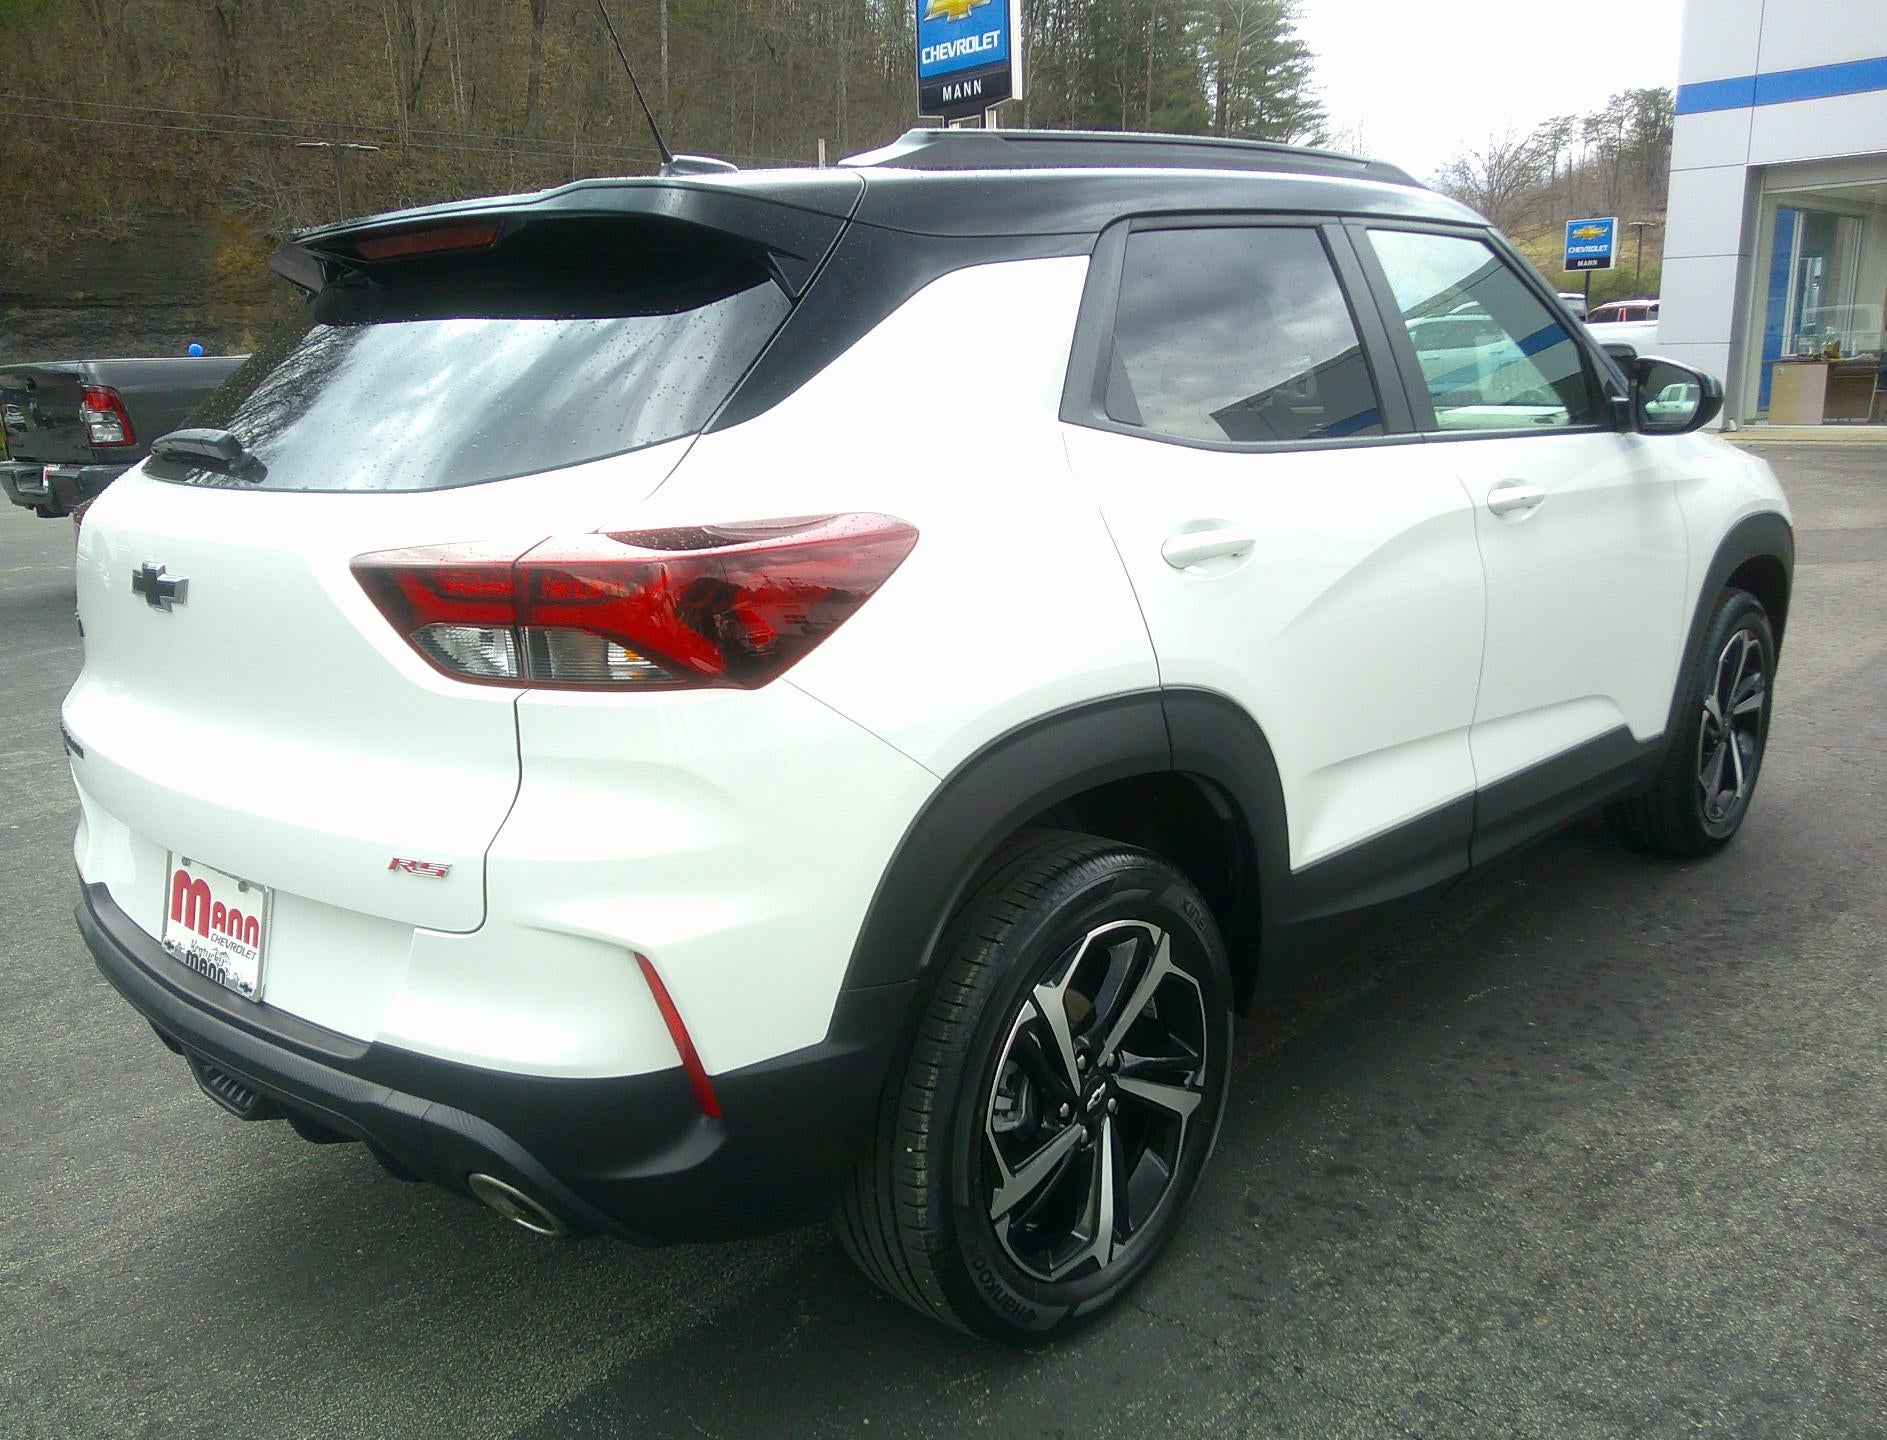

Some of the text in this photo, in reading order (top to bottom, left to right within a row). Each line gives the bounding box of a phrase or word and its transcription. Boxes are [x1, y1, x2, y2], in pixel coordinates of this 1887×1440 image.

[921, 30, 1001, 65] CHEVROLET
[942, 78, 983, 102] MANN
[1567, 244, 1609, 254] CHEVROLET
[1577, 259, 1598, 267] MANN
[388, 855, 452, 880] RS
[210, 933, 257, 961] CHEVROLET
